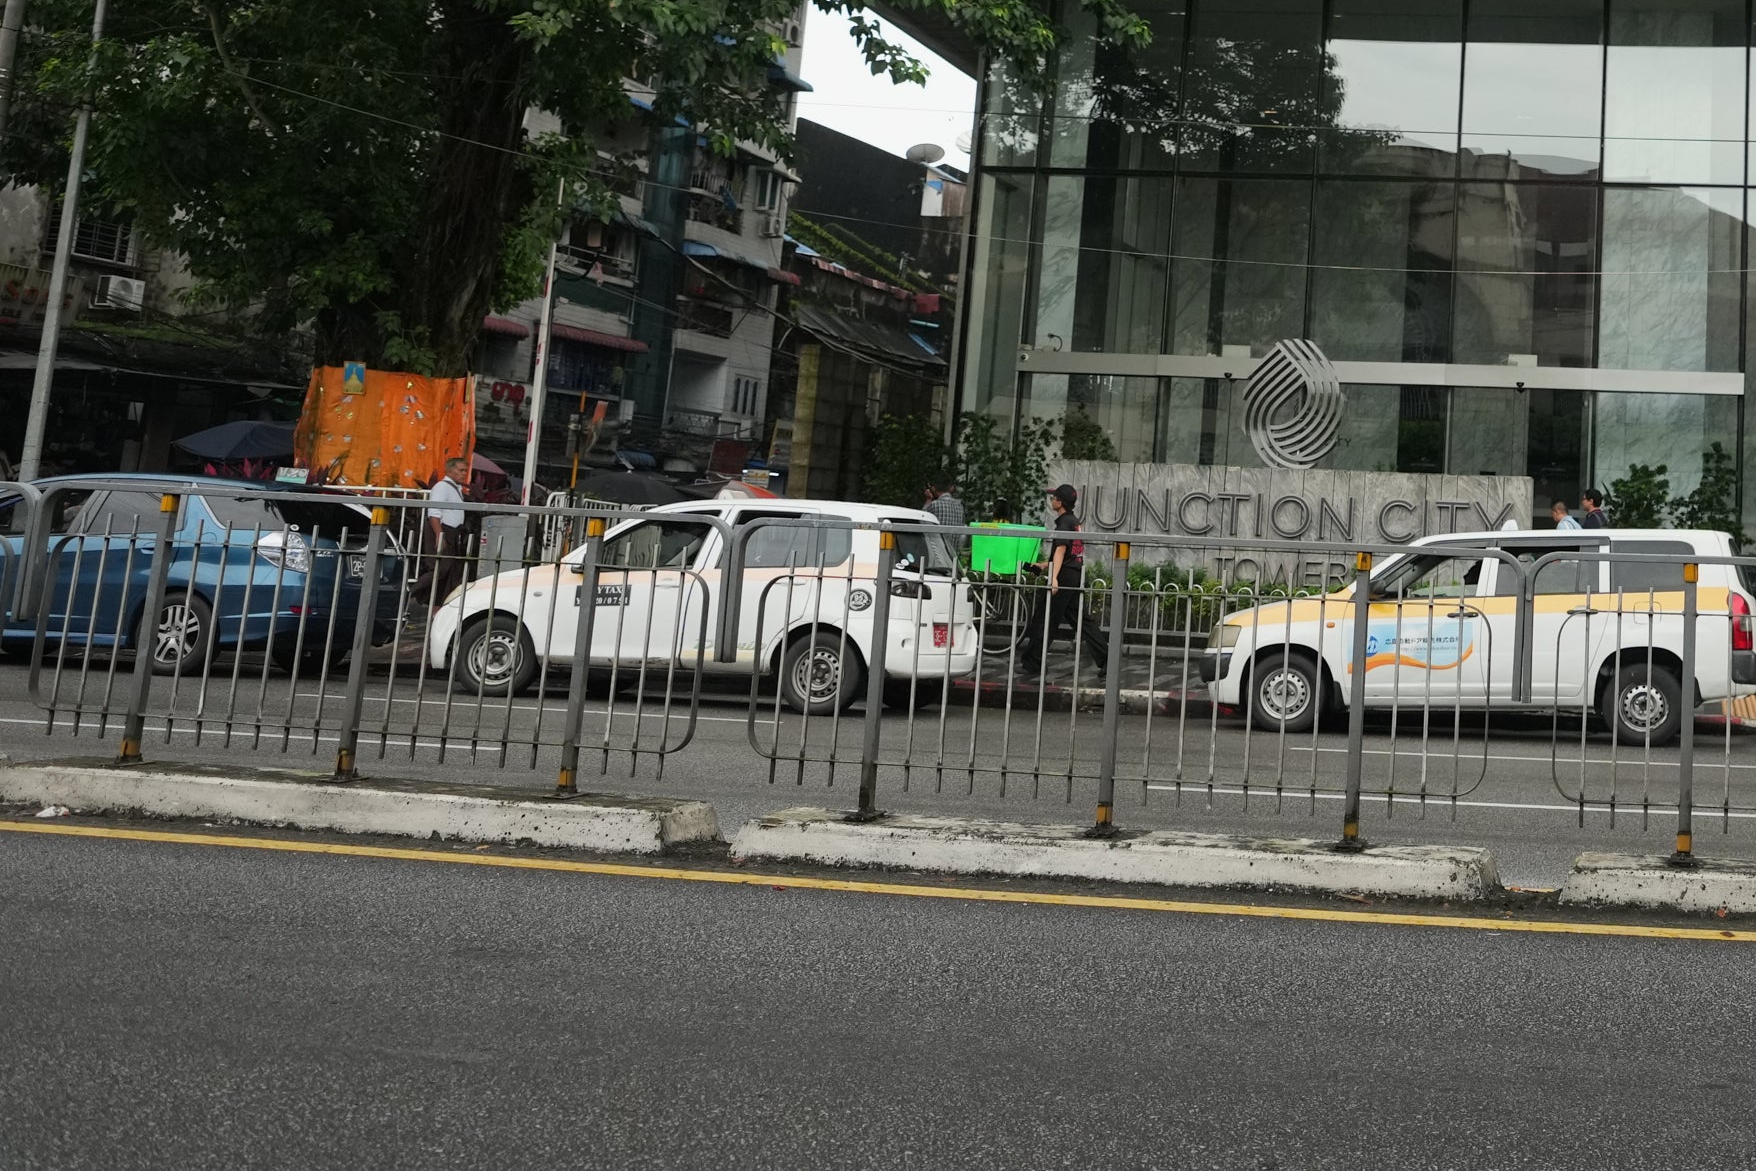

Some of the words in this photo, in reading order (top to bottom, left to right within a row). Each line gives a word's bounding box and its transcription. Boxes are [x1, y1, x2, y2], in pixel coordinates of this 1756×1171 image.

[1077, 484, 1355, 541] JUNCTION
[1377, 499, 1516, 544] CITY
[1213, 555, 1349, 587] TOWER
[605, 585, 623, 595] TAX
